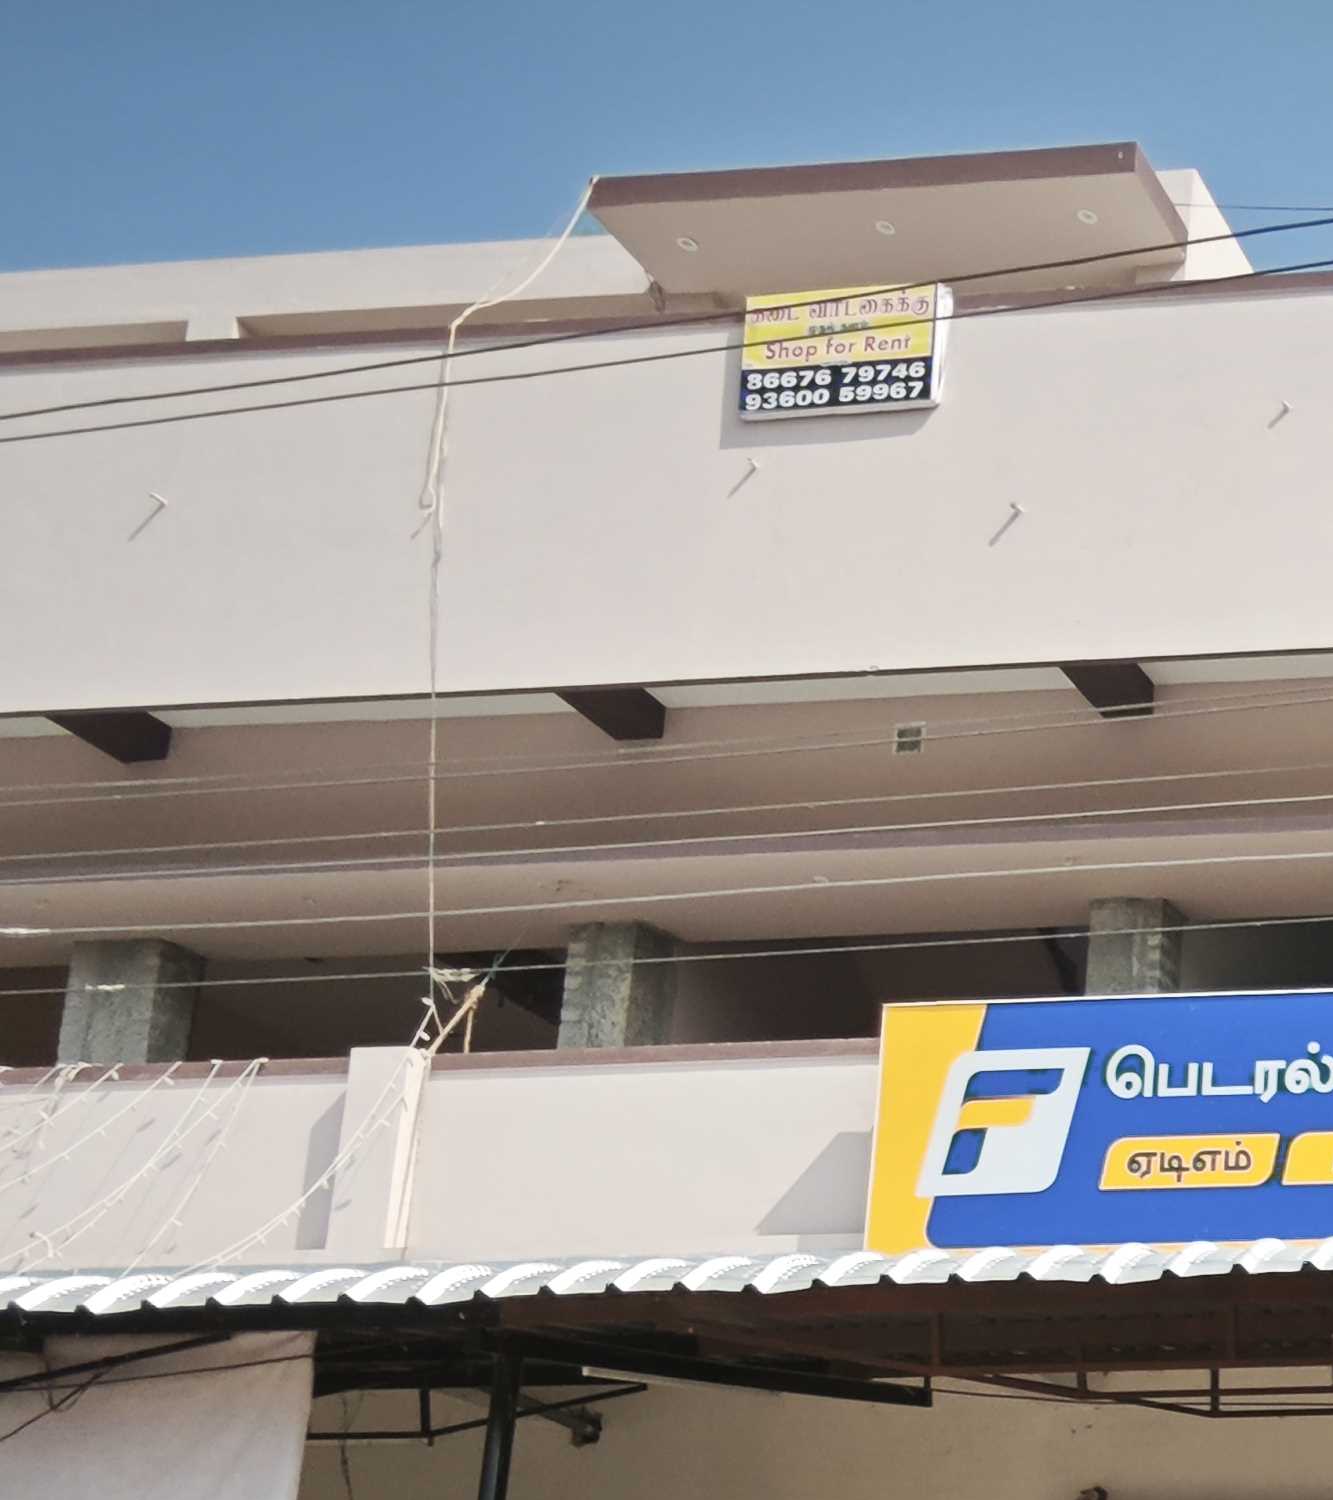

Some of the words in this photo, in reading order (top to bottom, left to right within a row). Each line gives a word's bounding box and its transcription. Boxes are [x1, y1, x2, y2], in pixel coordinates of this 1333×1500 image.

[765, 340, 818, 362] Shop
[826, 335, 856, 355] for
[864, 335, 912, 353] Rent
[746, 368, 832, 391] 86676
[841, 361, 926, 384] 79746
[745, 388, 830, 411] 93600
[838, 381, 924, 402] 59967
[1126, 1139, 1252, 1181] ஏடிஎம்
